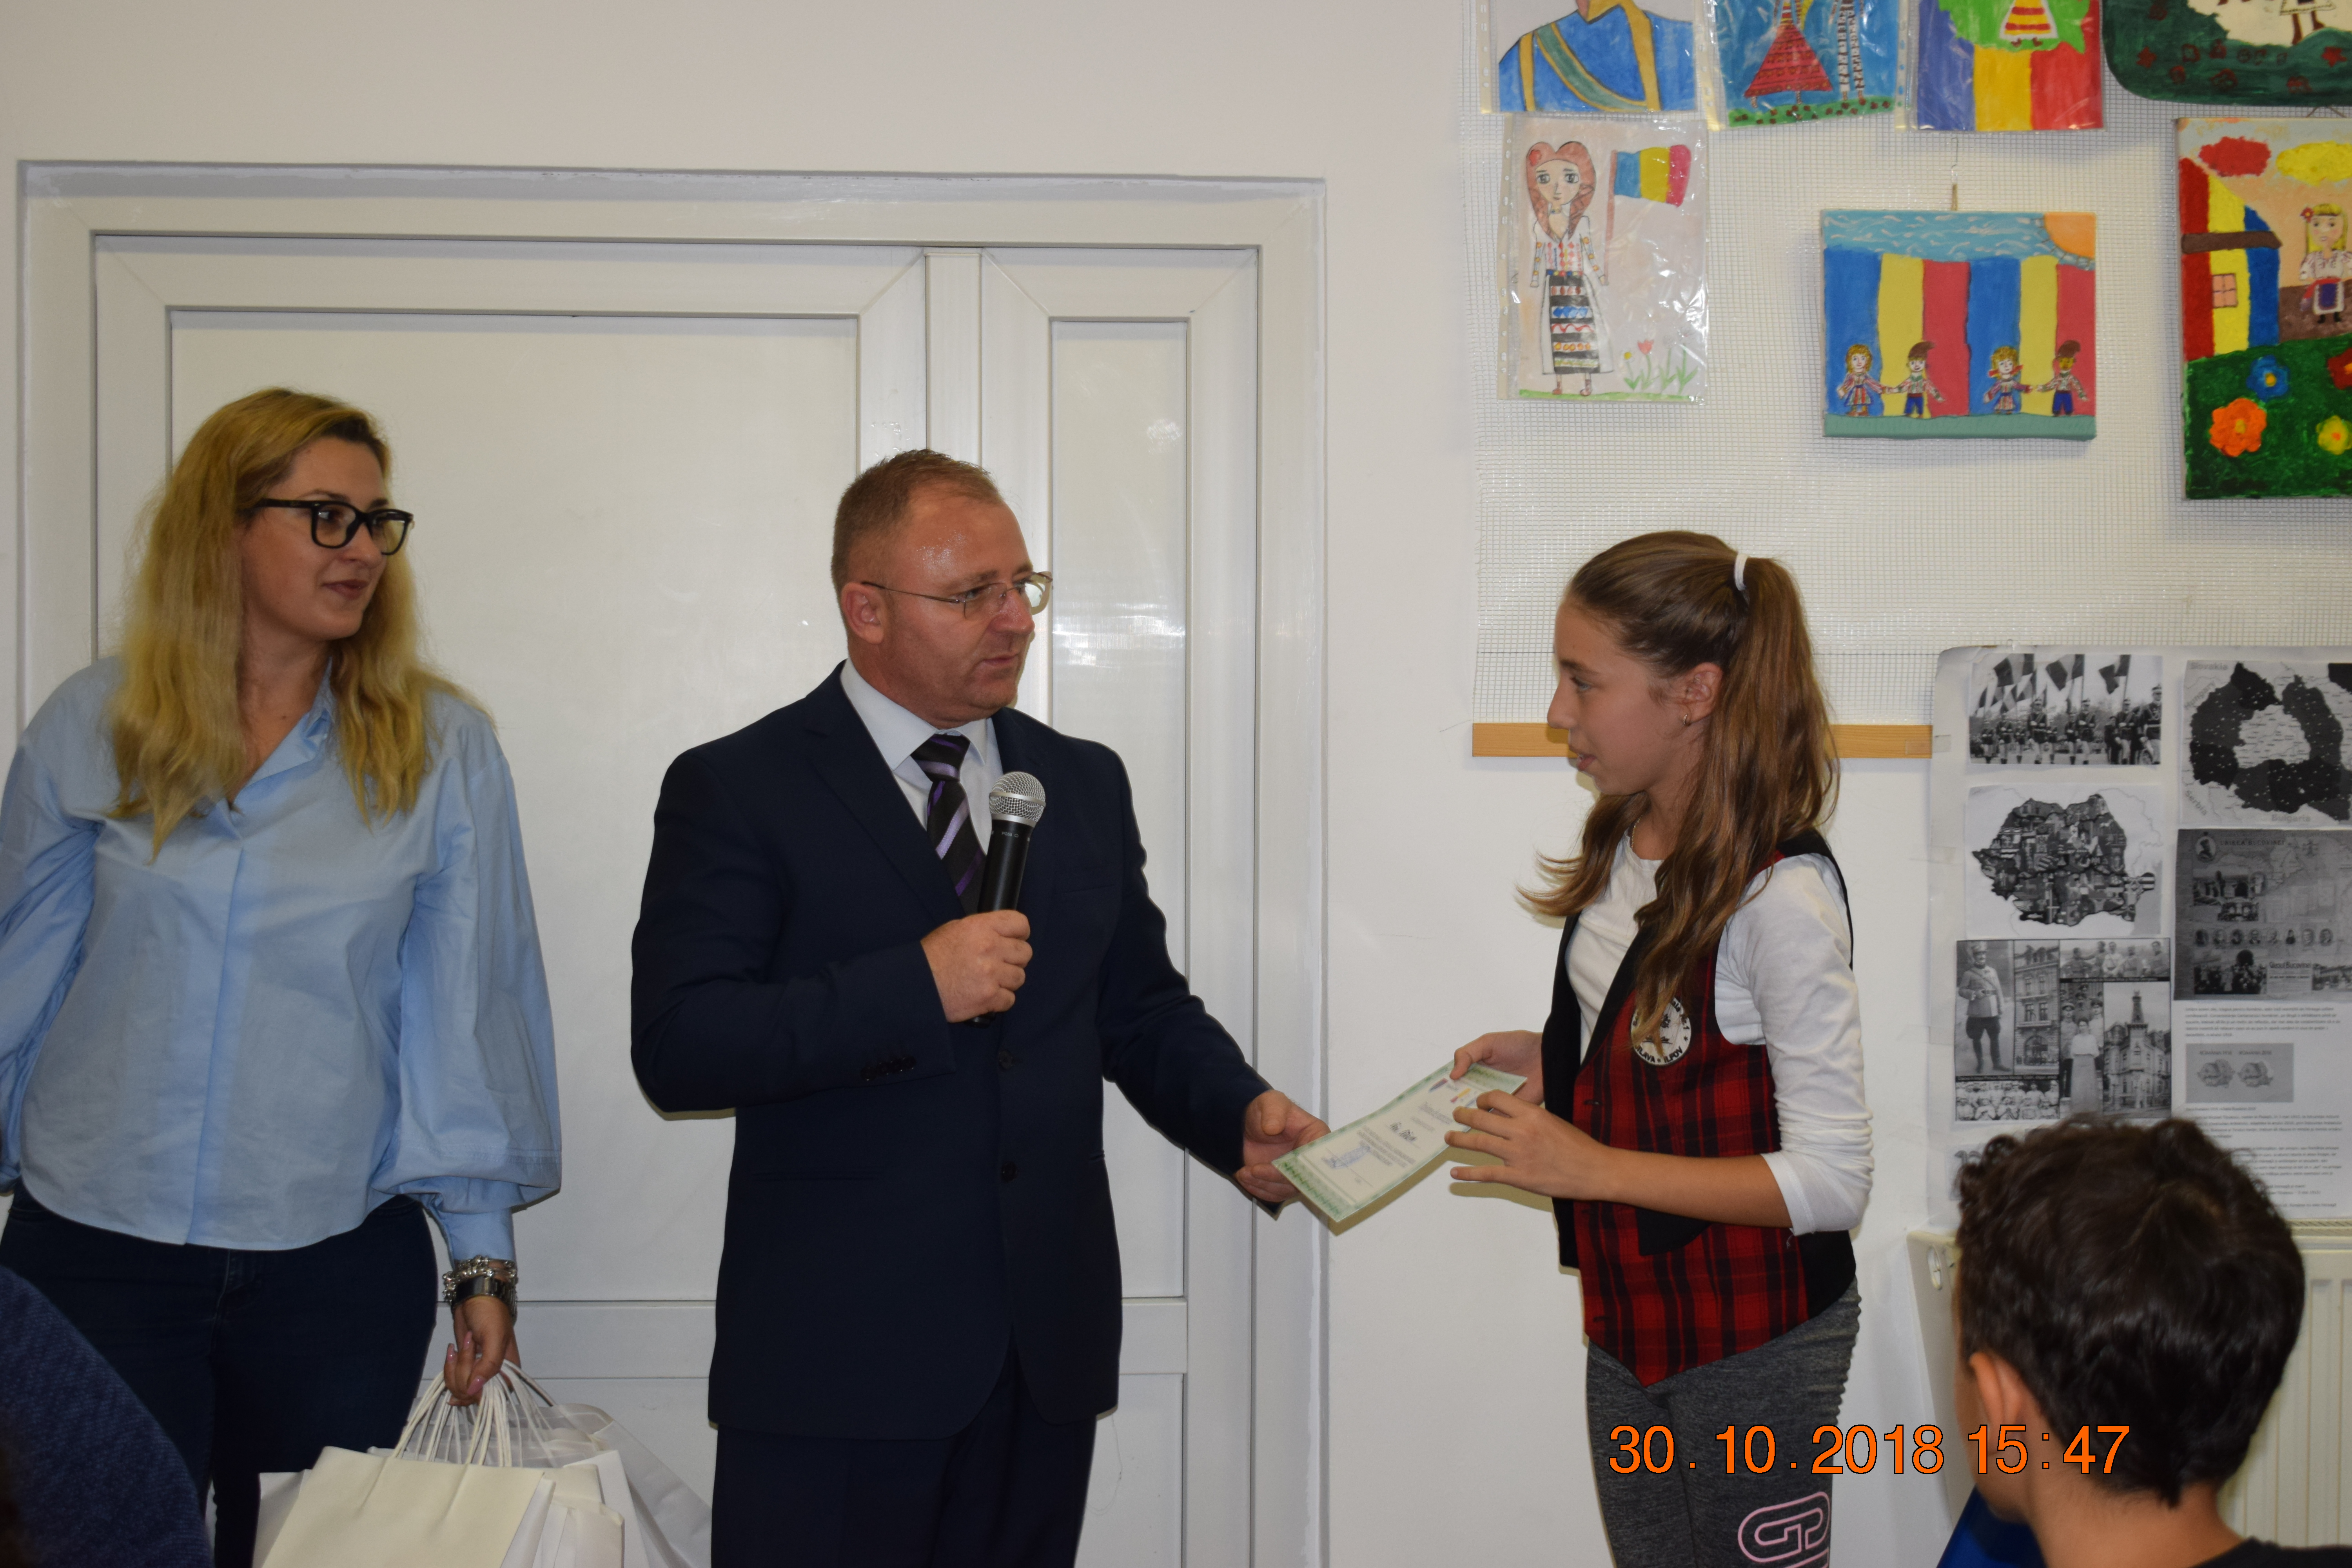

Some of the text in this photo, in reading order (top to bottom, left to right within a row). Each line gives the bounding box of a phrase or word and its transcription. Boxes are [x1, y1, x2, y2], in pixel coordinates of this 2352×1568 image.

[2190, 662, 2228, 670] Slovakia
[2185, 790, 2207, 816] Serbia
[2271, 814, 2311, 823] Bulgaria
[1663, 1046, 1683, 1063] ILFOV
